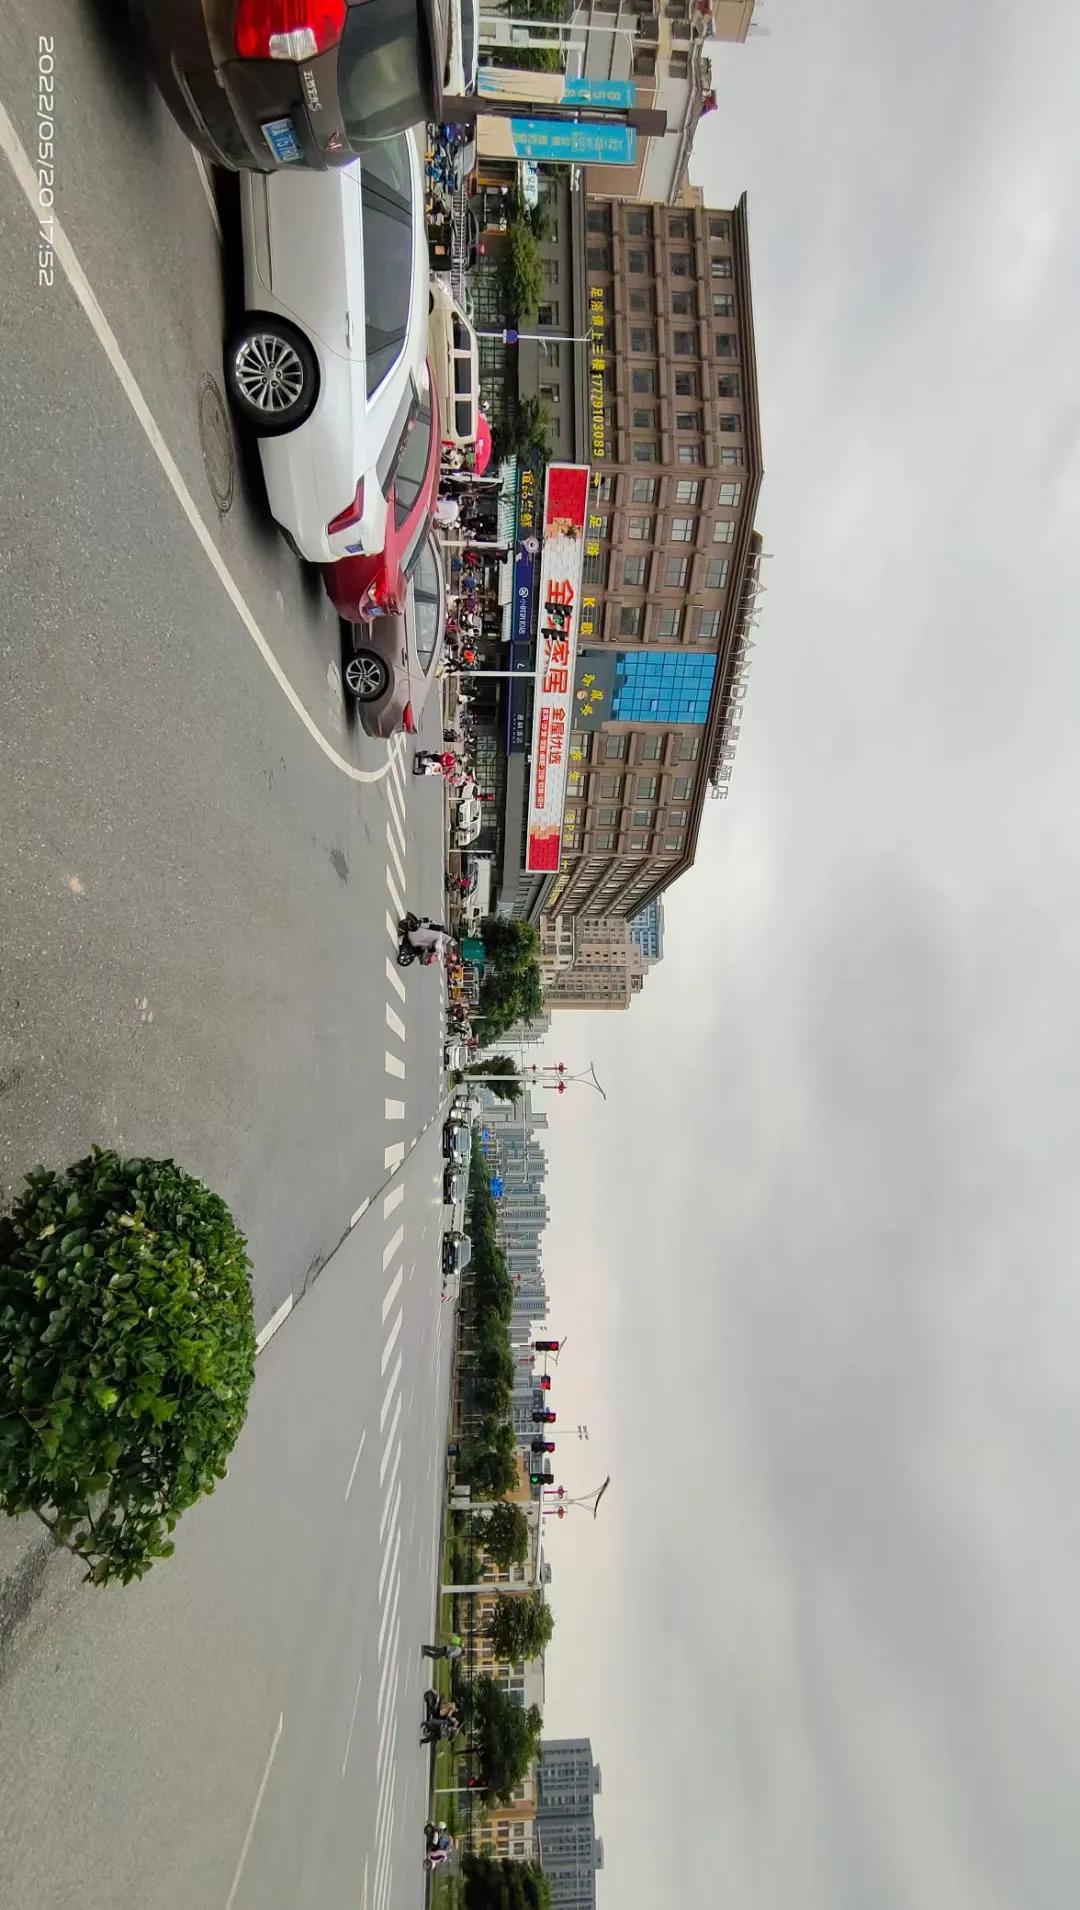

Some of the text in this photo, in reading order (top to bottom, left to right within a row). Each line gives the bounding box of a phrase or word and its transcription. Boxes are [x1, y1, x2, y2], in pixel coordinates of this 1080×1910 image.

[590, 287, 606, 457] 足浴请上三楼 17779103089
[726, 553, 776, 720] LAVANDE
[549, 708, 566, 764] 全屋优选
